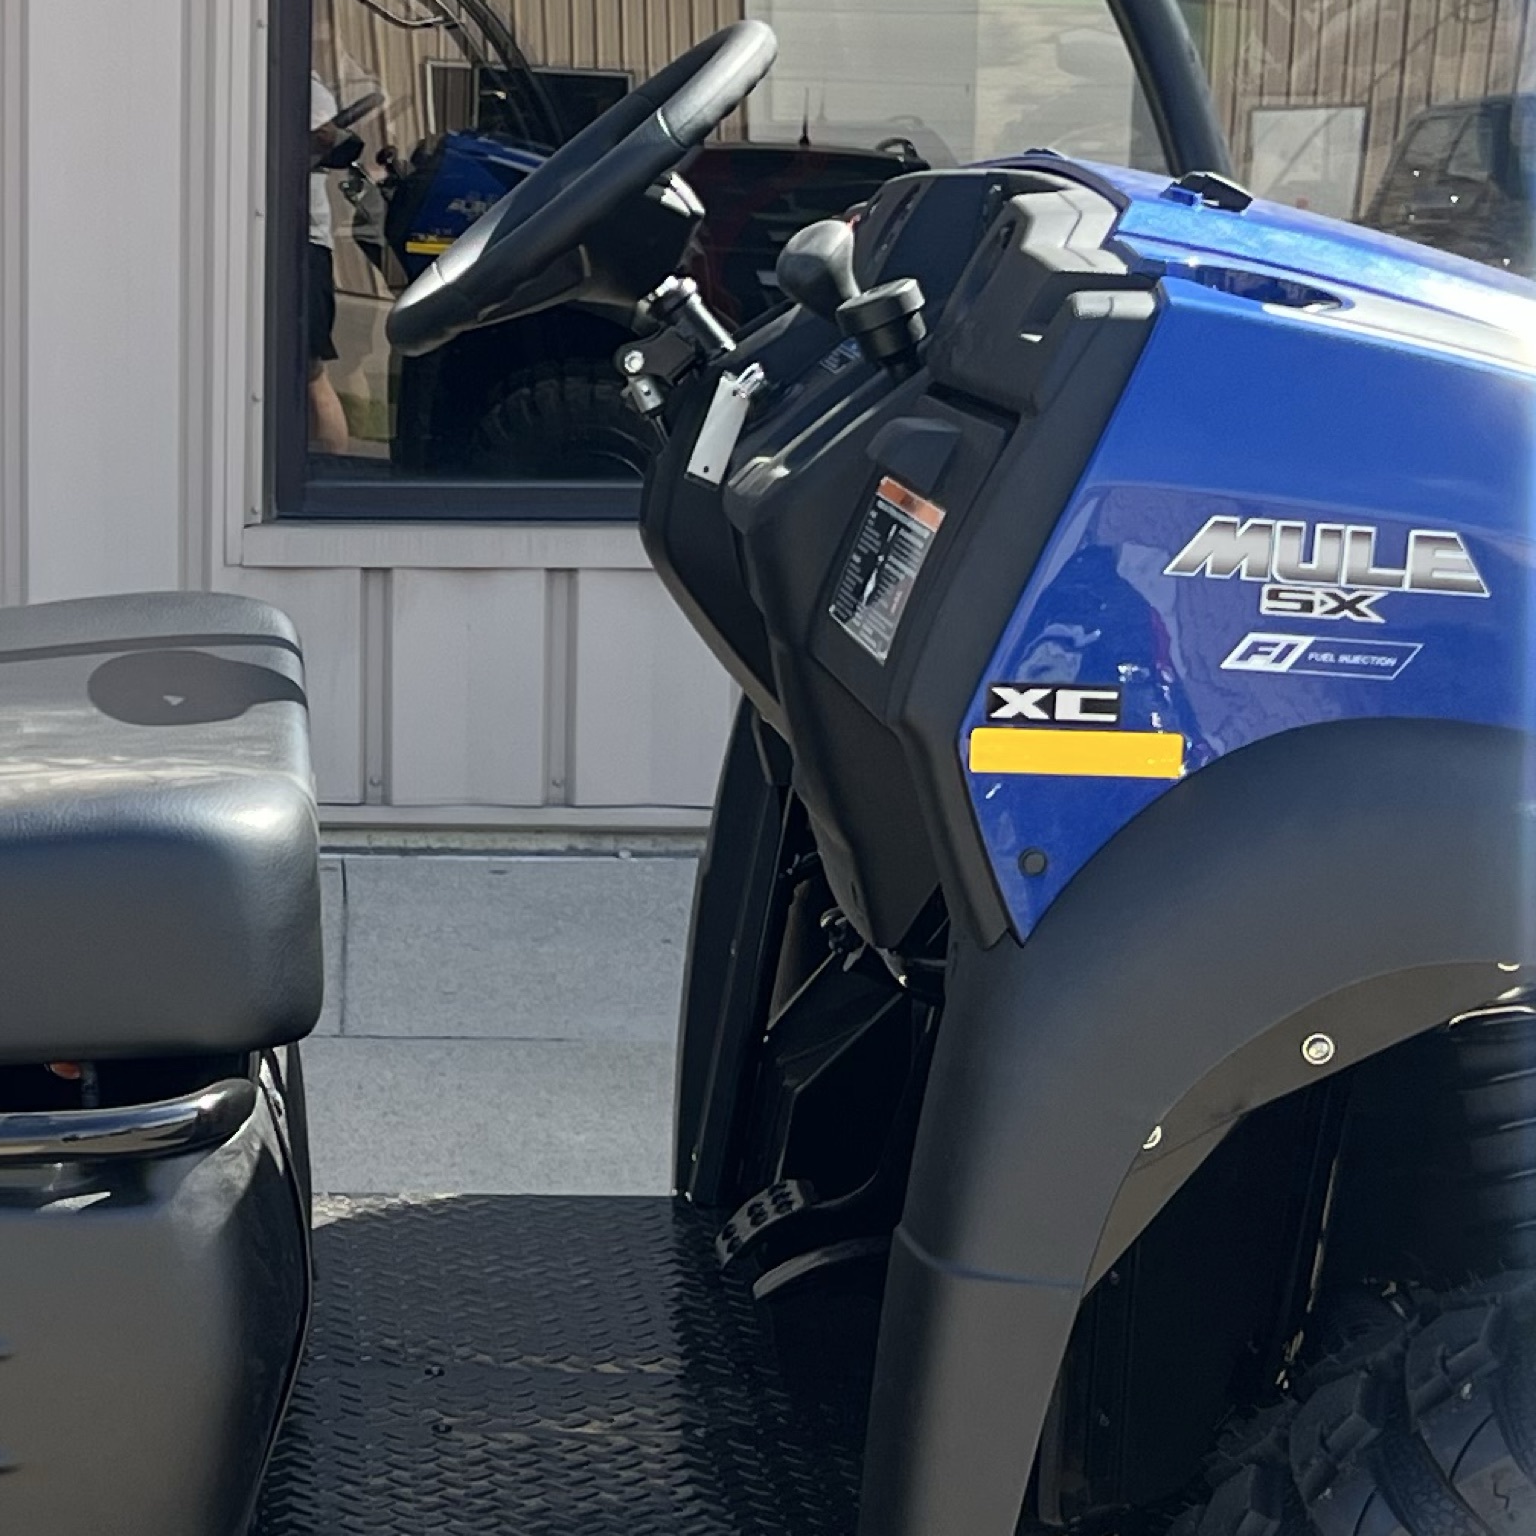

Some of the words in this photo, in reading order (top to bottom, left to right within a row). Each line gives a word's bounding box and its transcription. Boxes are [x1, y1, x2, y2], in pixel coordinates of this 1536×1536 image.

[1162, 514, 1491, 598] MULE
[1259, 583, 1389, 624] SX
[1231, 638, 1306, 667] FI
[1307, 651, 1336, 664] FUEL
[1337, 653, 1398, 668] INJECTION
[989, 685, 1120, 722] XC
